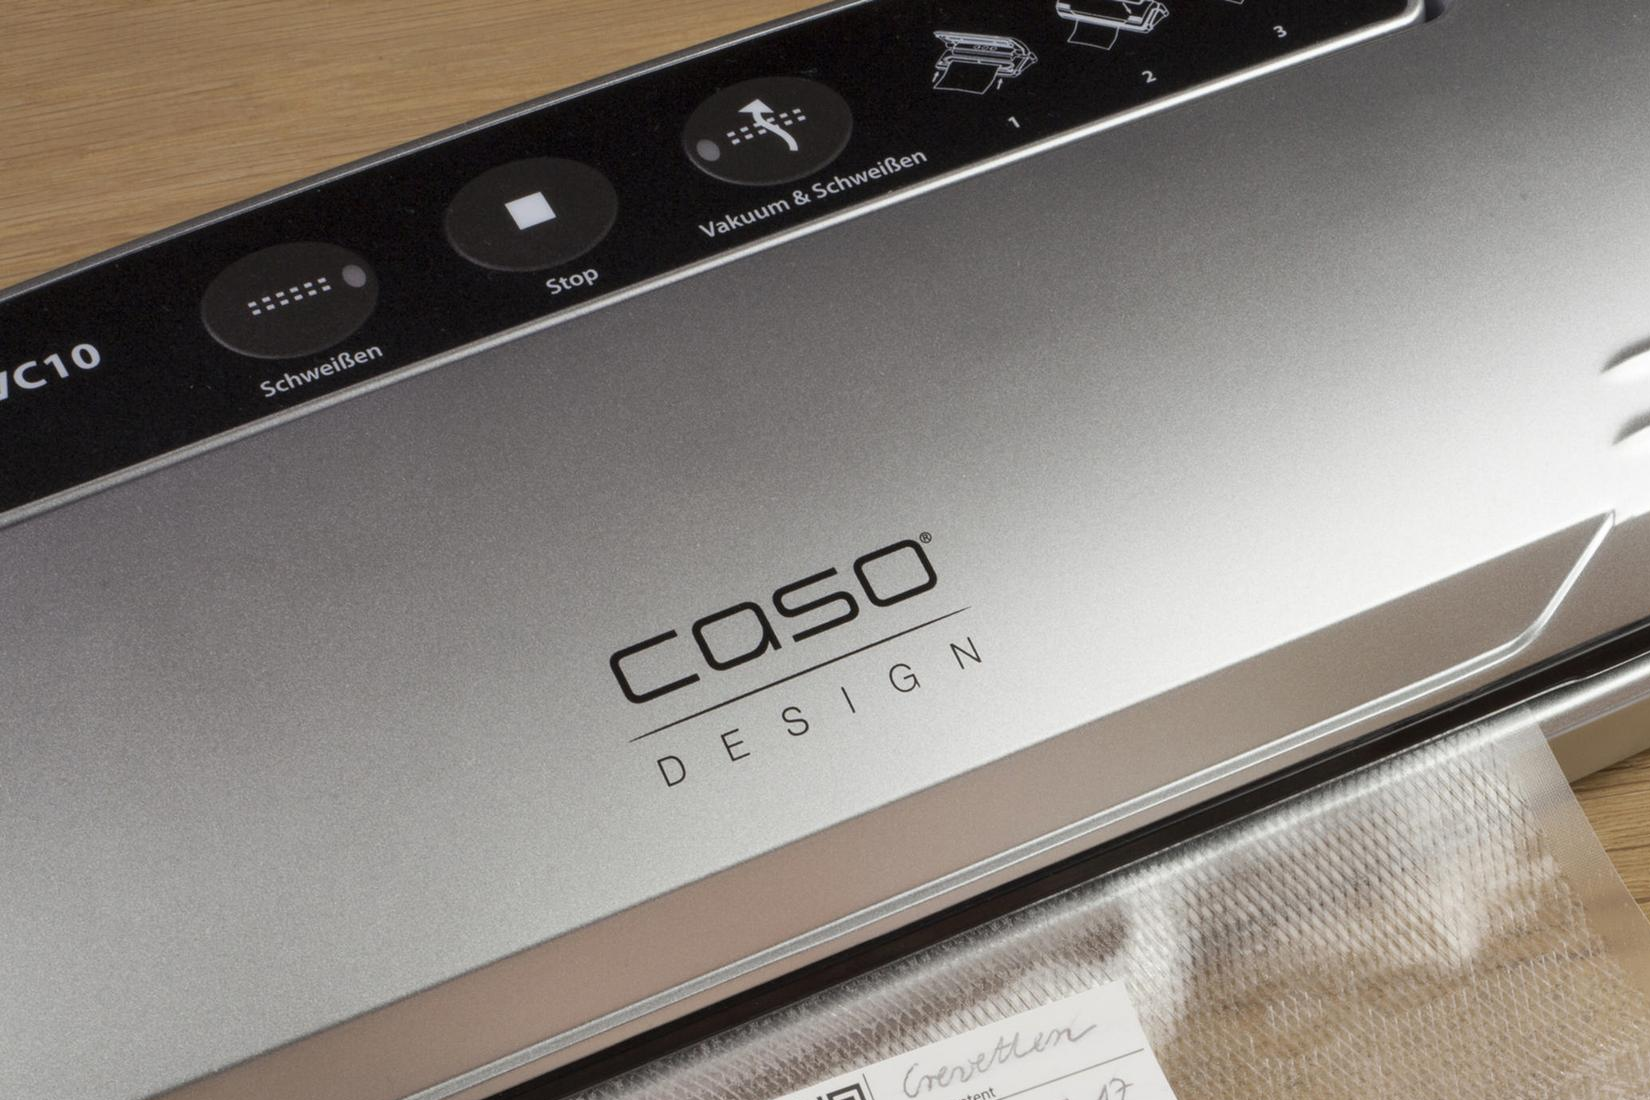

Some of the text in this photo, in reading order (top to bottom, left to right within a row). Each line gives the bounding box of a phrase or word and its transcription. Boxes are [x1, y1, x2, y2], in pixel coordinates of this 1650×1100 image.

[1273, 25, 1288, 39] 3
[1142, 70, 1156, 83] 2
[1008, 116, 1020, 129] 1
[698, 151, 928, 238] Vakuum & Schweißen
[545, 266, 599, 295] Stop
[259, 344, 384, 398] Schweißen
[656, 637, 982, 787] DESIGN
